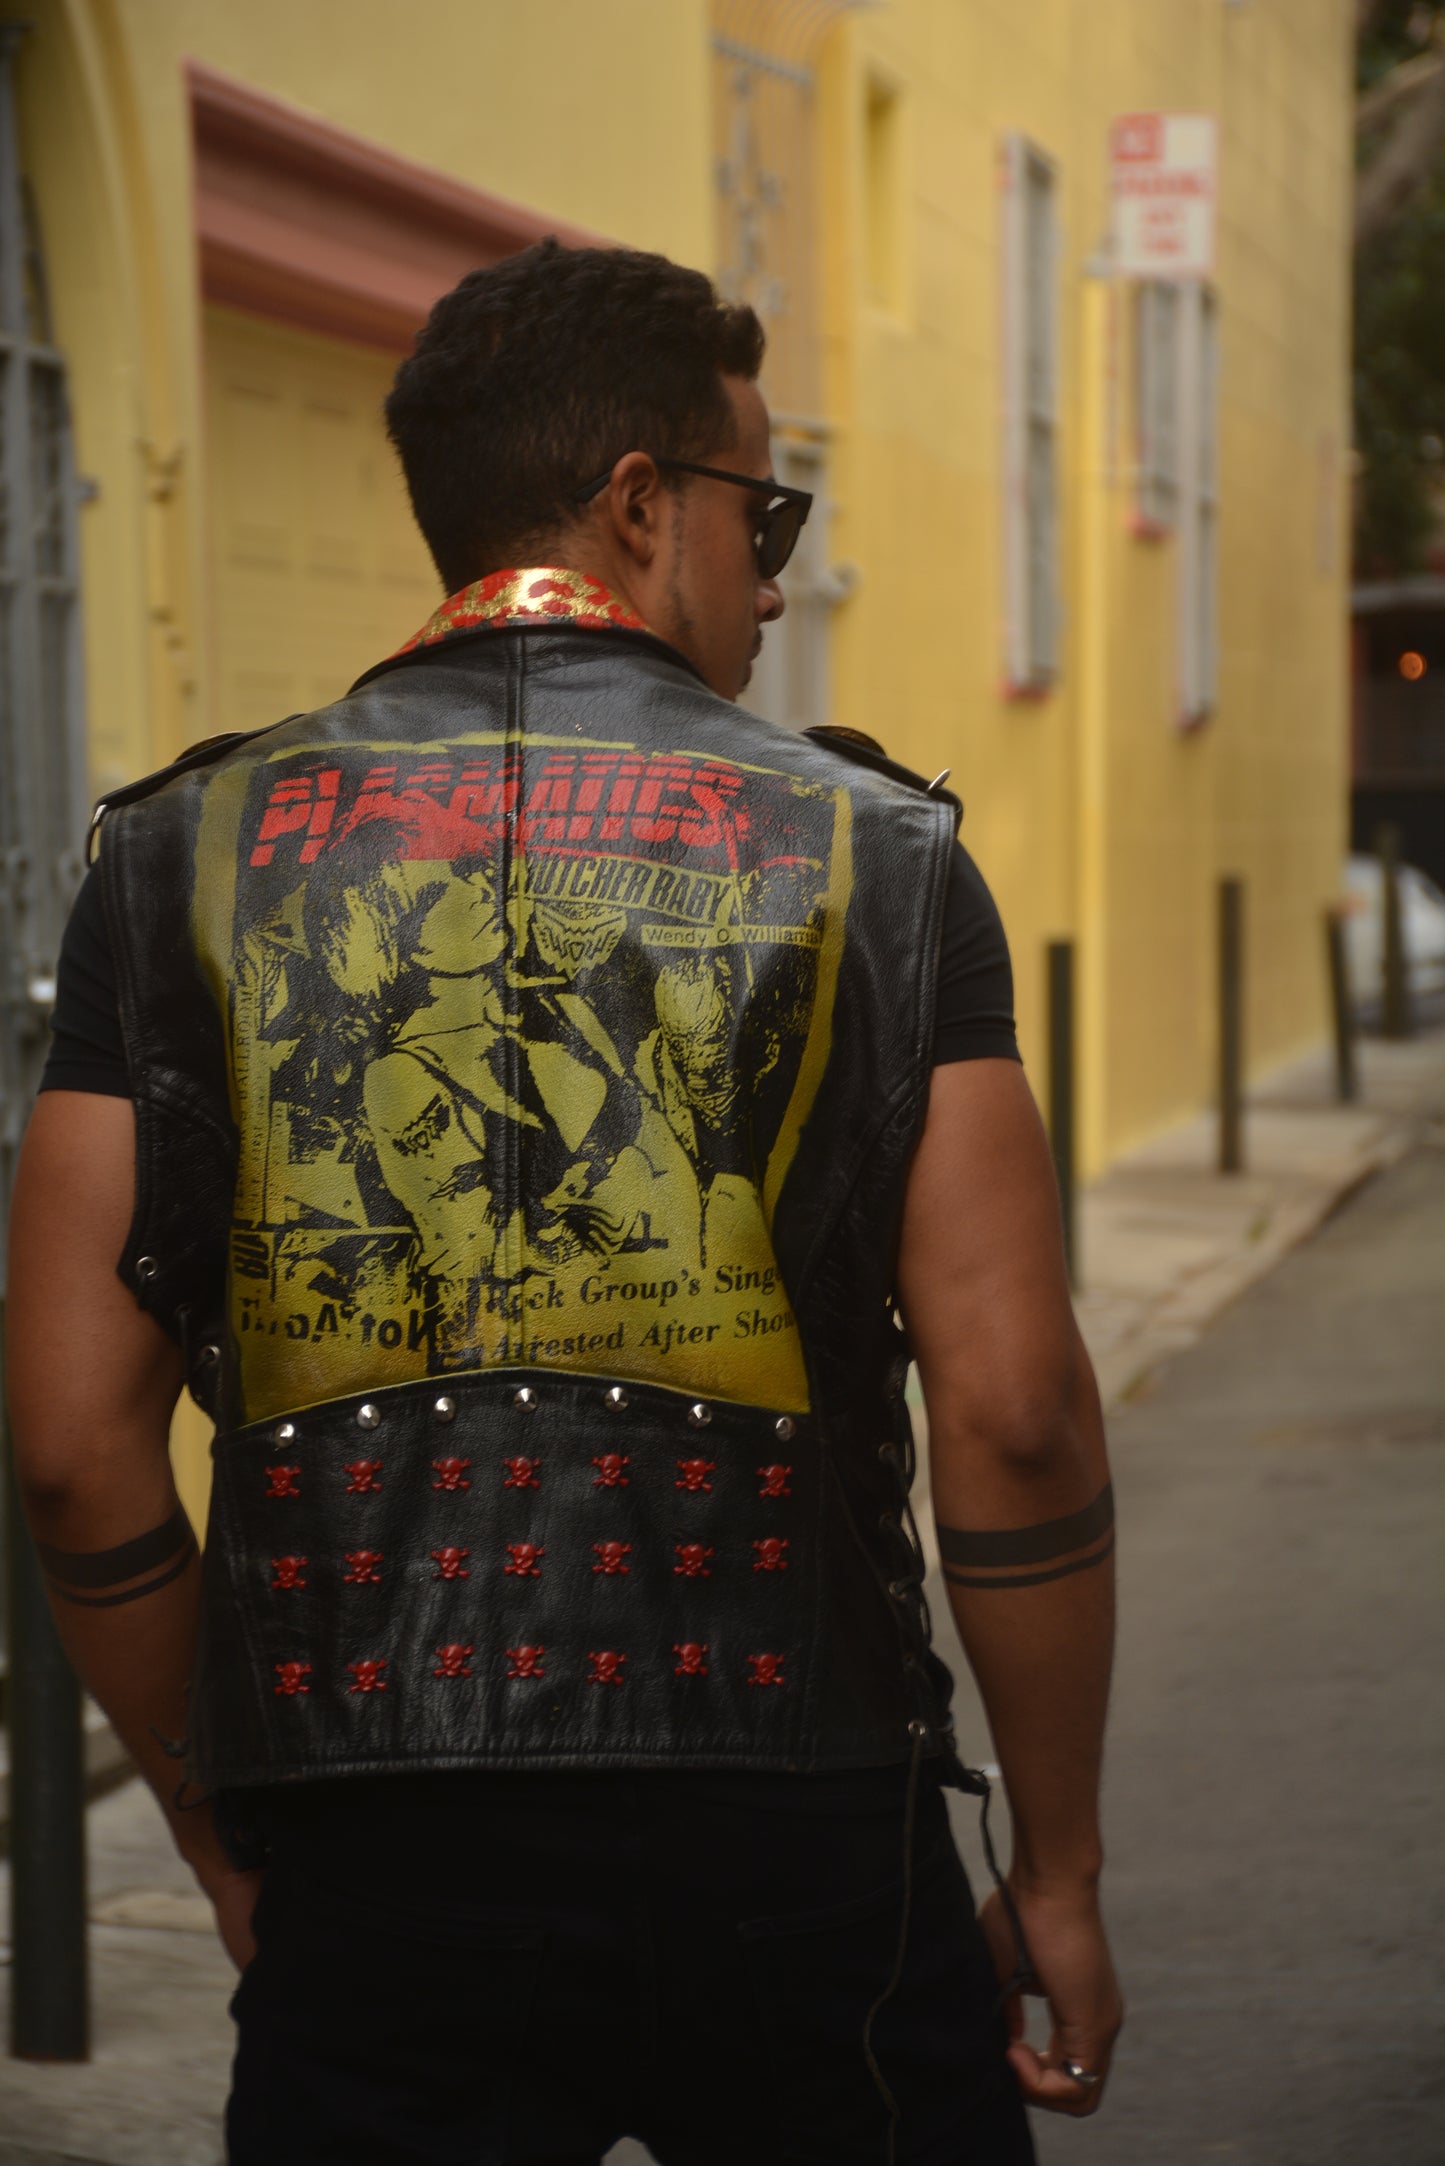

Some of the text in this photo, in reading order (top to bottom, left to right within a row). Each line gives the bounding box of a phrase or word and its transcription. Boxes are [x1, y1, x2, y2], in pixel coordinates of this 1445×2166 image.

[648, 866, 729, 921] BABY
[646, 928, 707, 946] Wendy
[580, 1269, 700, 1307] Group's
[639, 1319, 720, 1354] After
